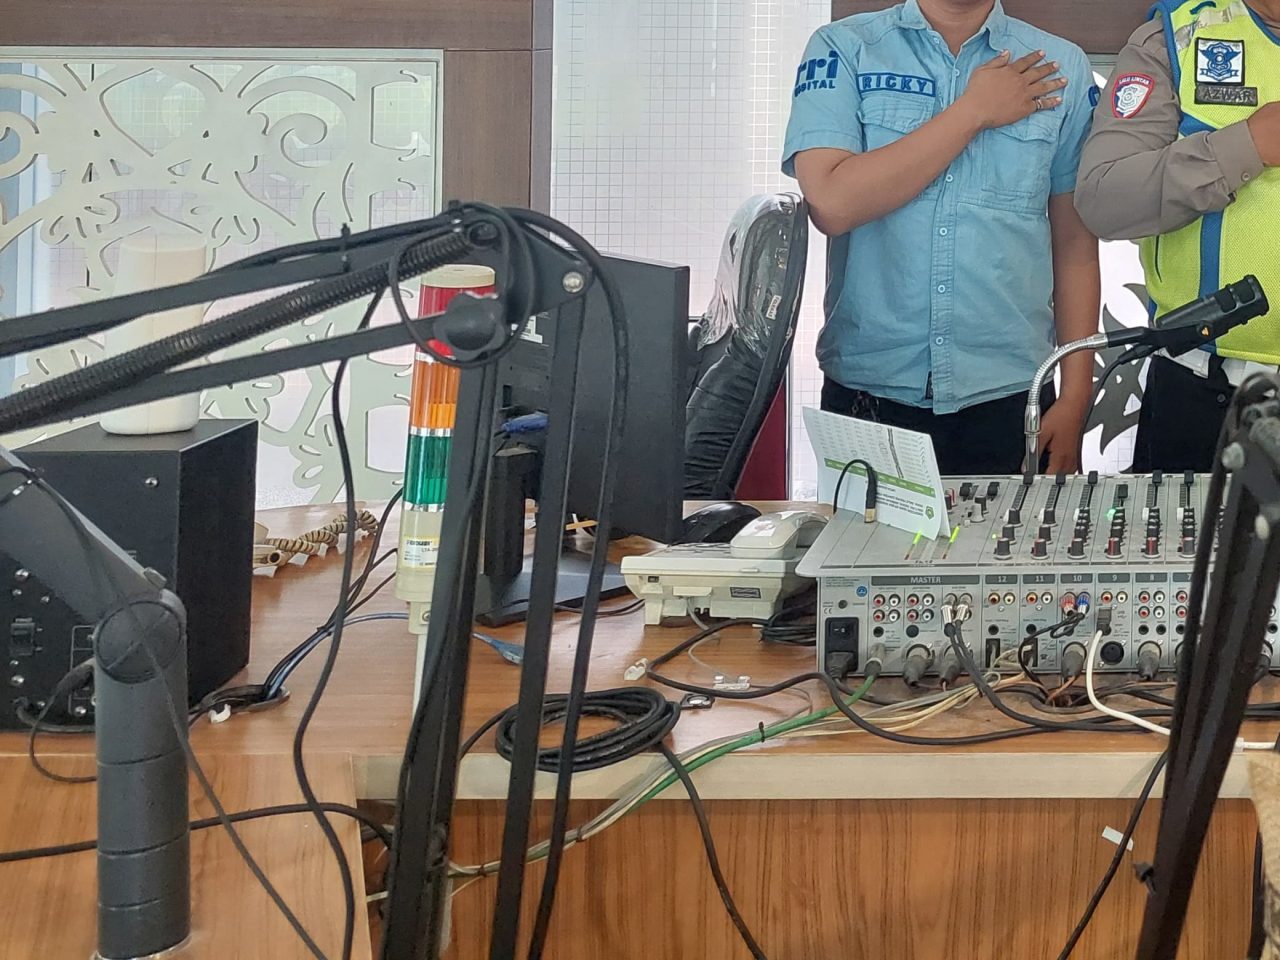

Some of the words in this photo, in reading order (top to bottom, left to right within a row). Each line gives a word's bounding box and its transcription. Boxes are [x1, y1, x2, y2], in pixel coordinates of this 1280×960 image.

[862, 74, 928, 92] RICKY
[910, 576, 941, 584] MASTER
[1073, 574, 1082, 582] 10
[1112, 574, 1118, 582] 9
